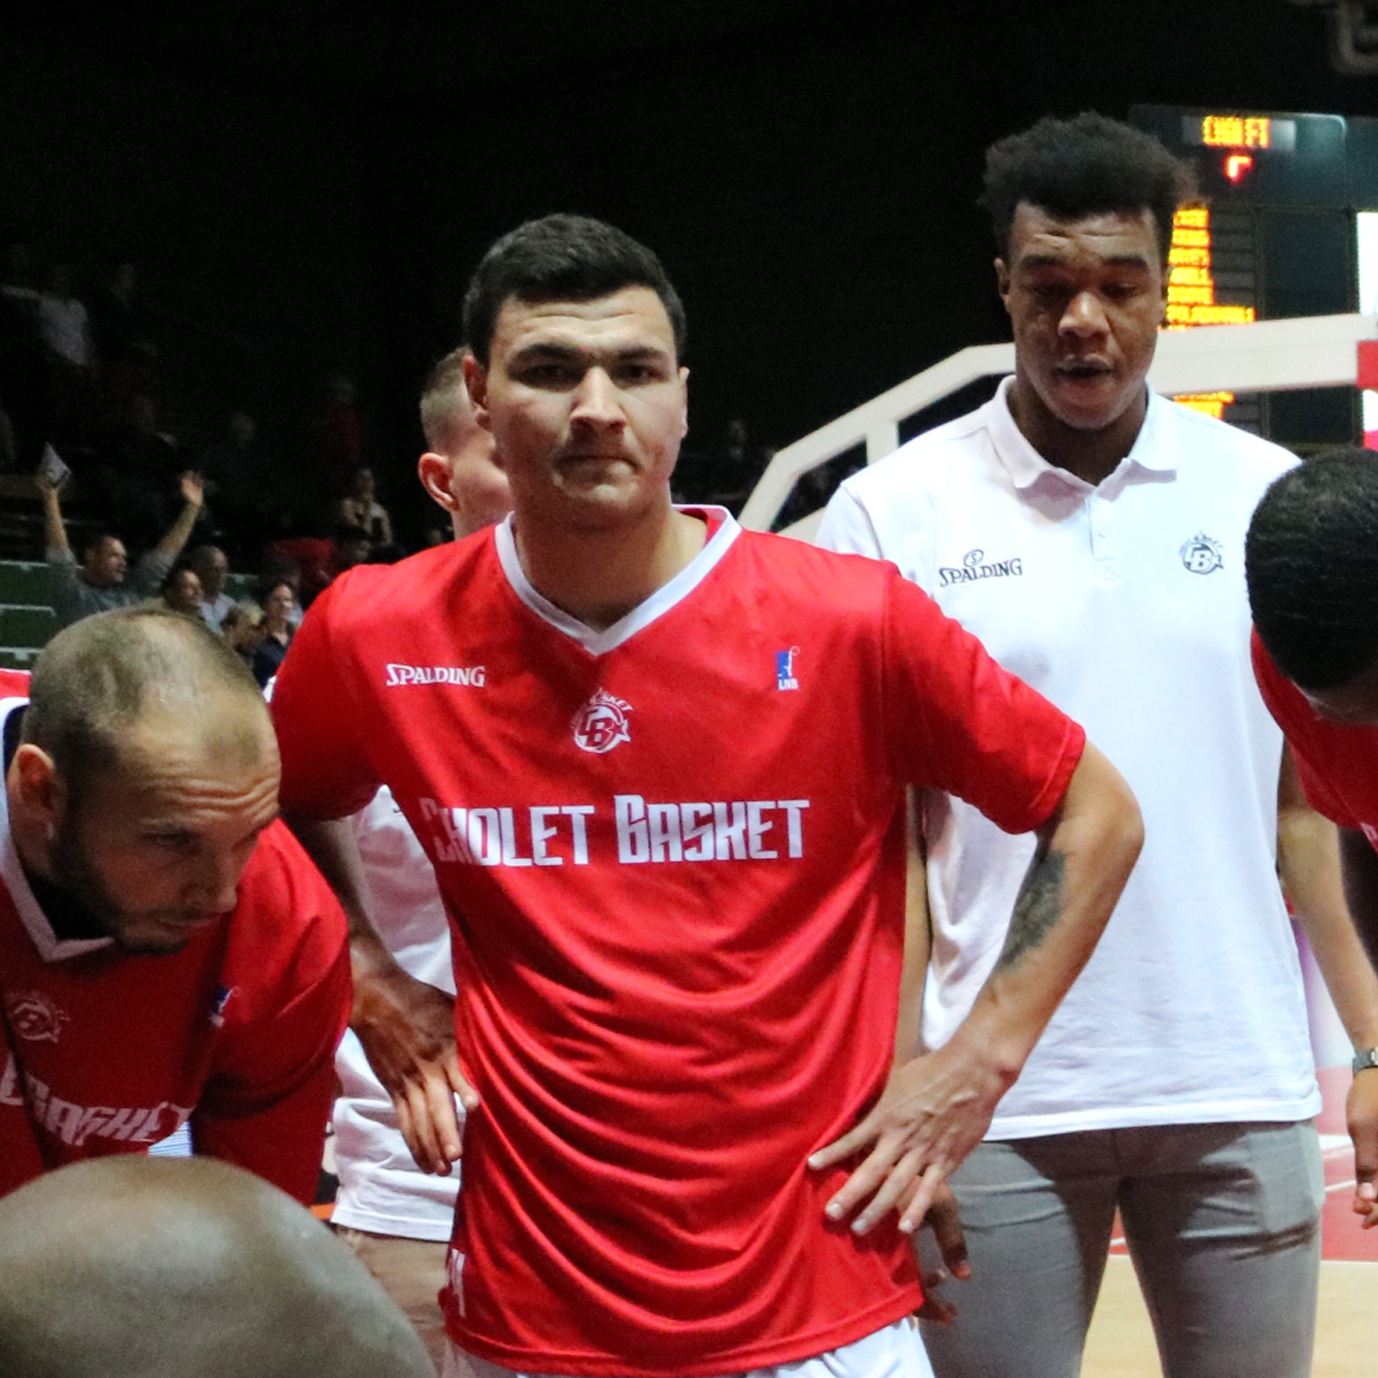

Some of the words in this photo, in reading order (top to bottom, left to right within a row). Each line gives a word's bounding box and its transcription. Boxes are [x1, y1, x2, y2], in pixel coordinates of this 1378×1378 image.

[938, 557, 1023, 588] SPALDING
[386, 662, 485, 688] SPALDING
[419, 797, 595, 867] CHOLET
[613, 794, 810, 864] BASKET
